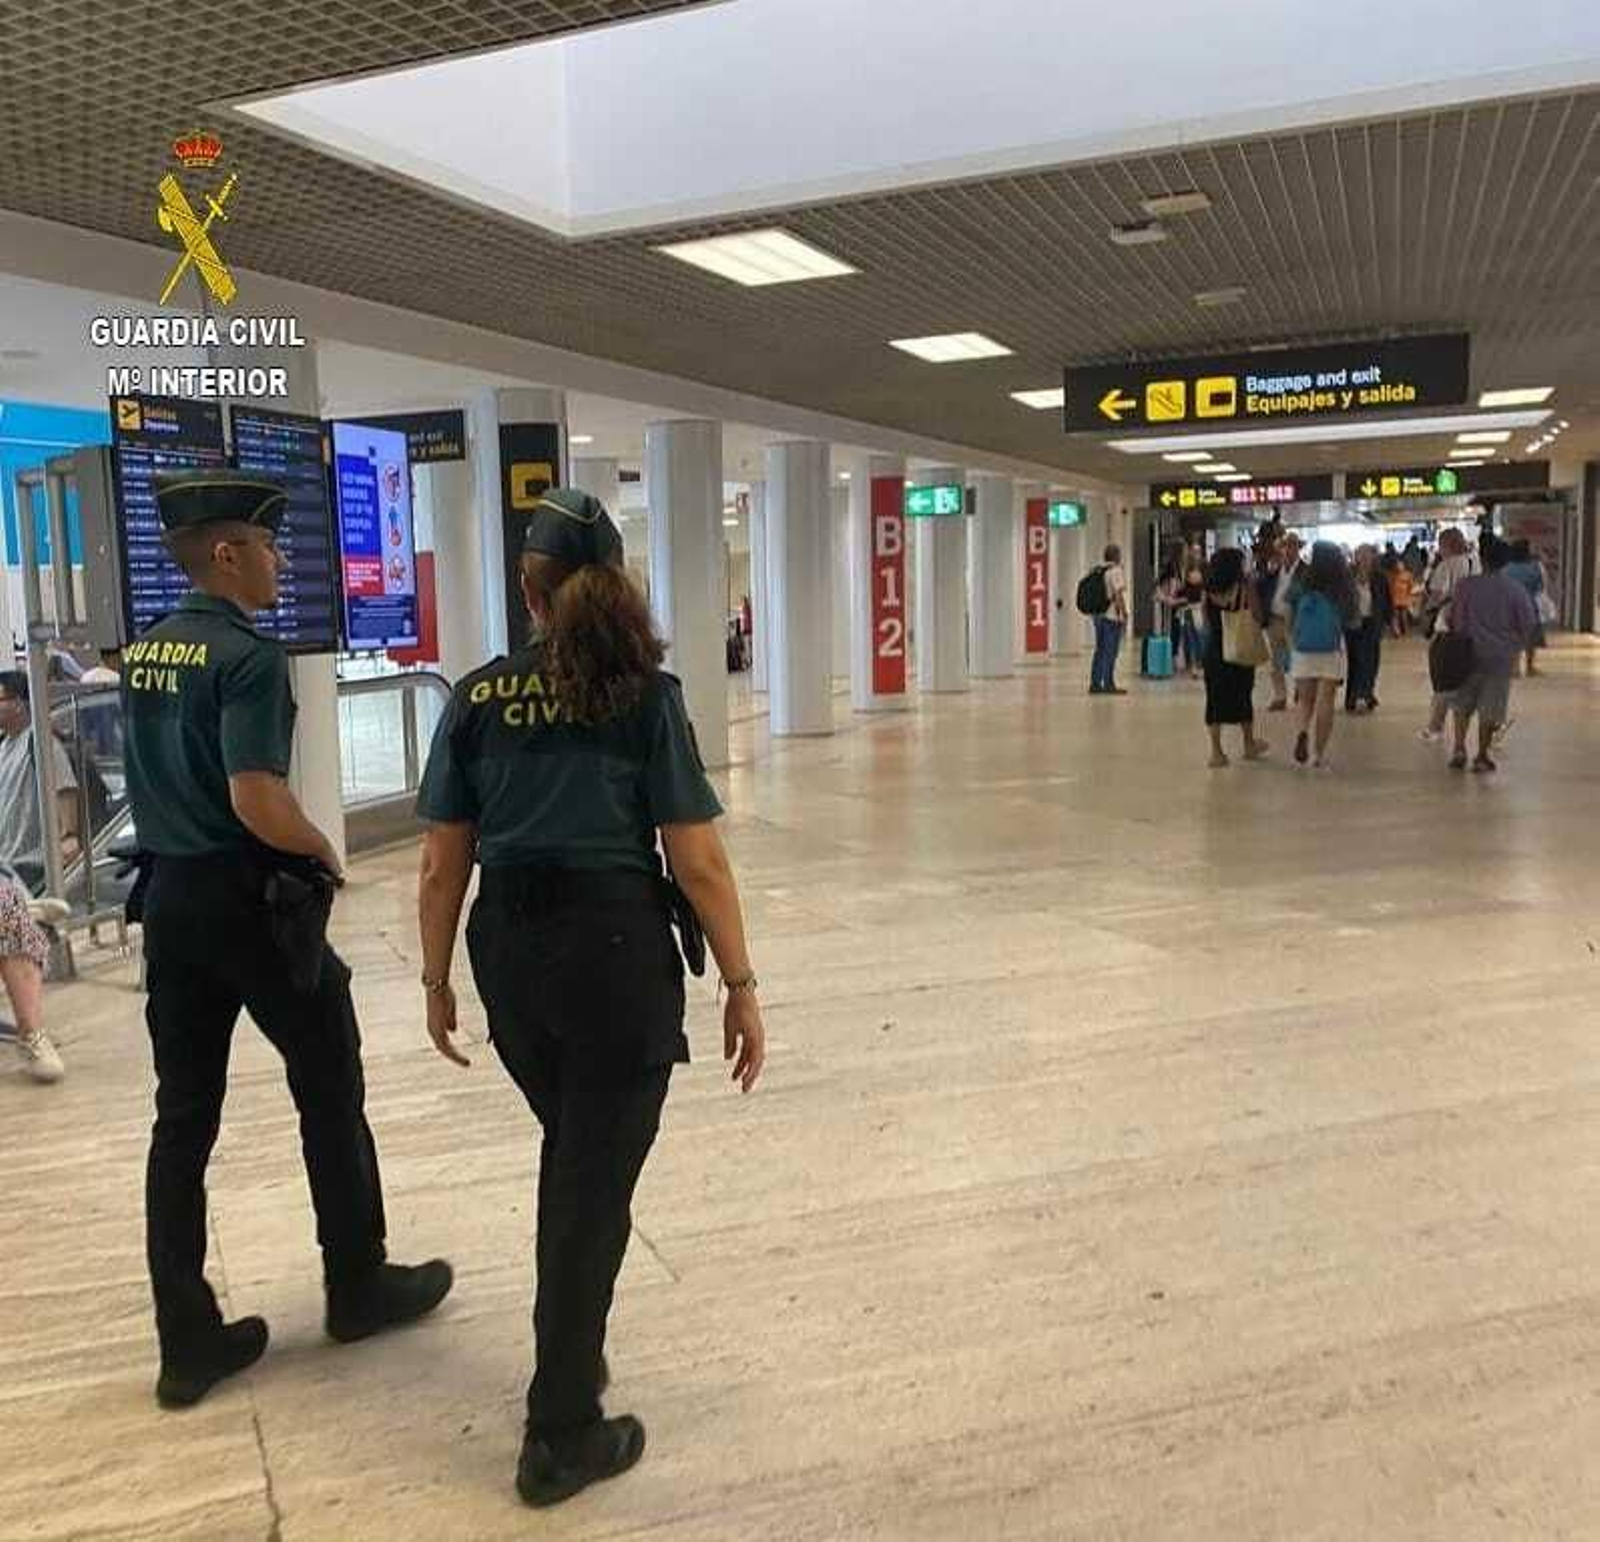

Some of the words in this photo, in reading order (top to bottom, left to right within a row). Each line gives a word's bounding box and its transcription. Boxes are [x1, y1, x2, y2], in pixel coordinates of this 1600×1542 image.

[1245, 375, 1312, 394] Baggage
[1316, 369, 1347, 387] and
[1351, 366, 1382, 384] exit
[1246, 391, 1336, 414] Equipajes
[1341, 390, 1353, 409] y
[1359, 384, 1416, 404] salida
[875, 516, 903, 657] B12
[1028, 526, 1046, 627] B11
[131, 667, 178, 693] CIVIL
